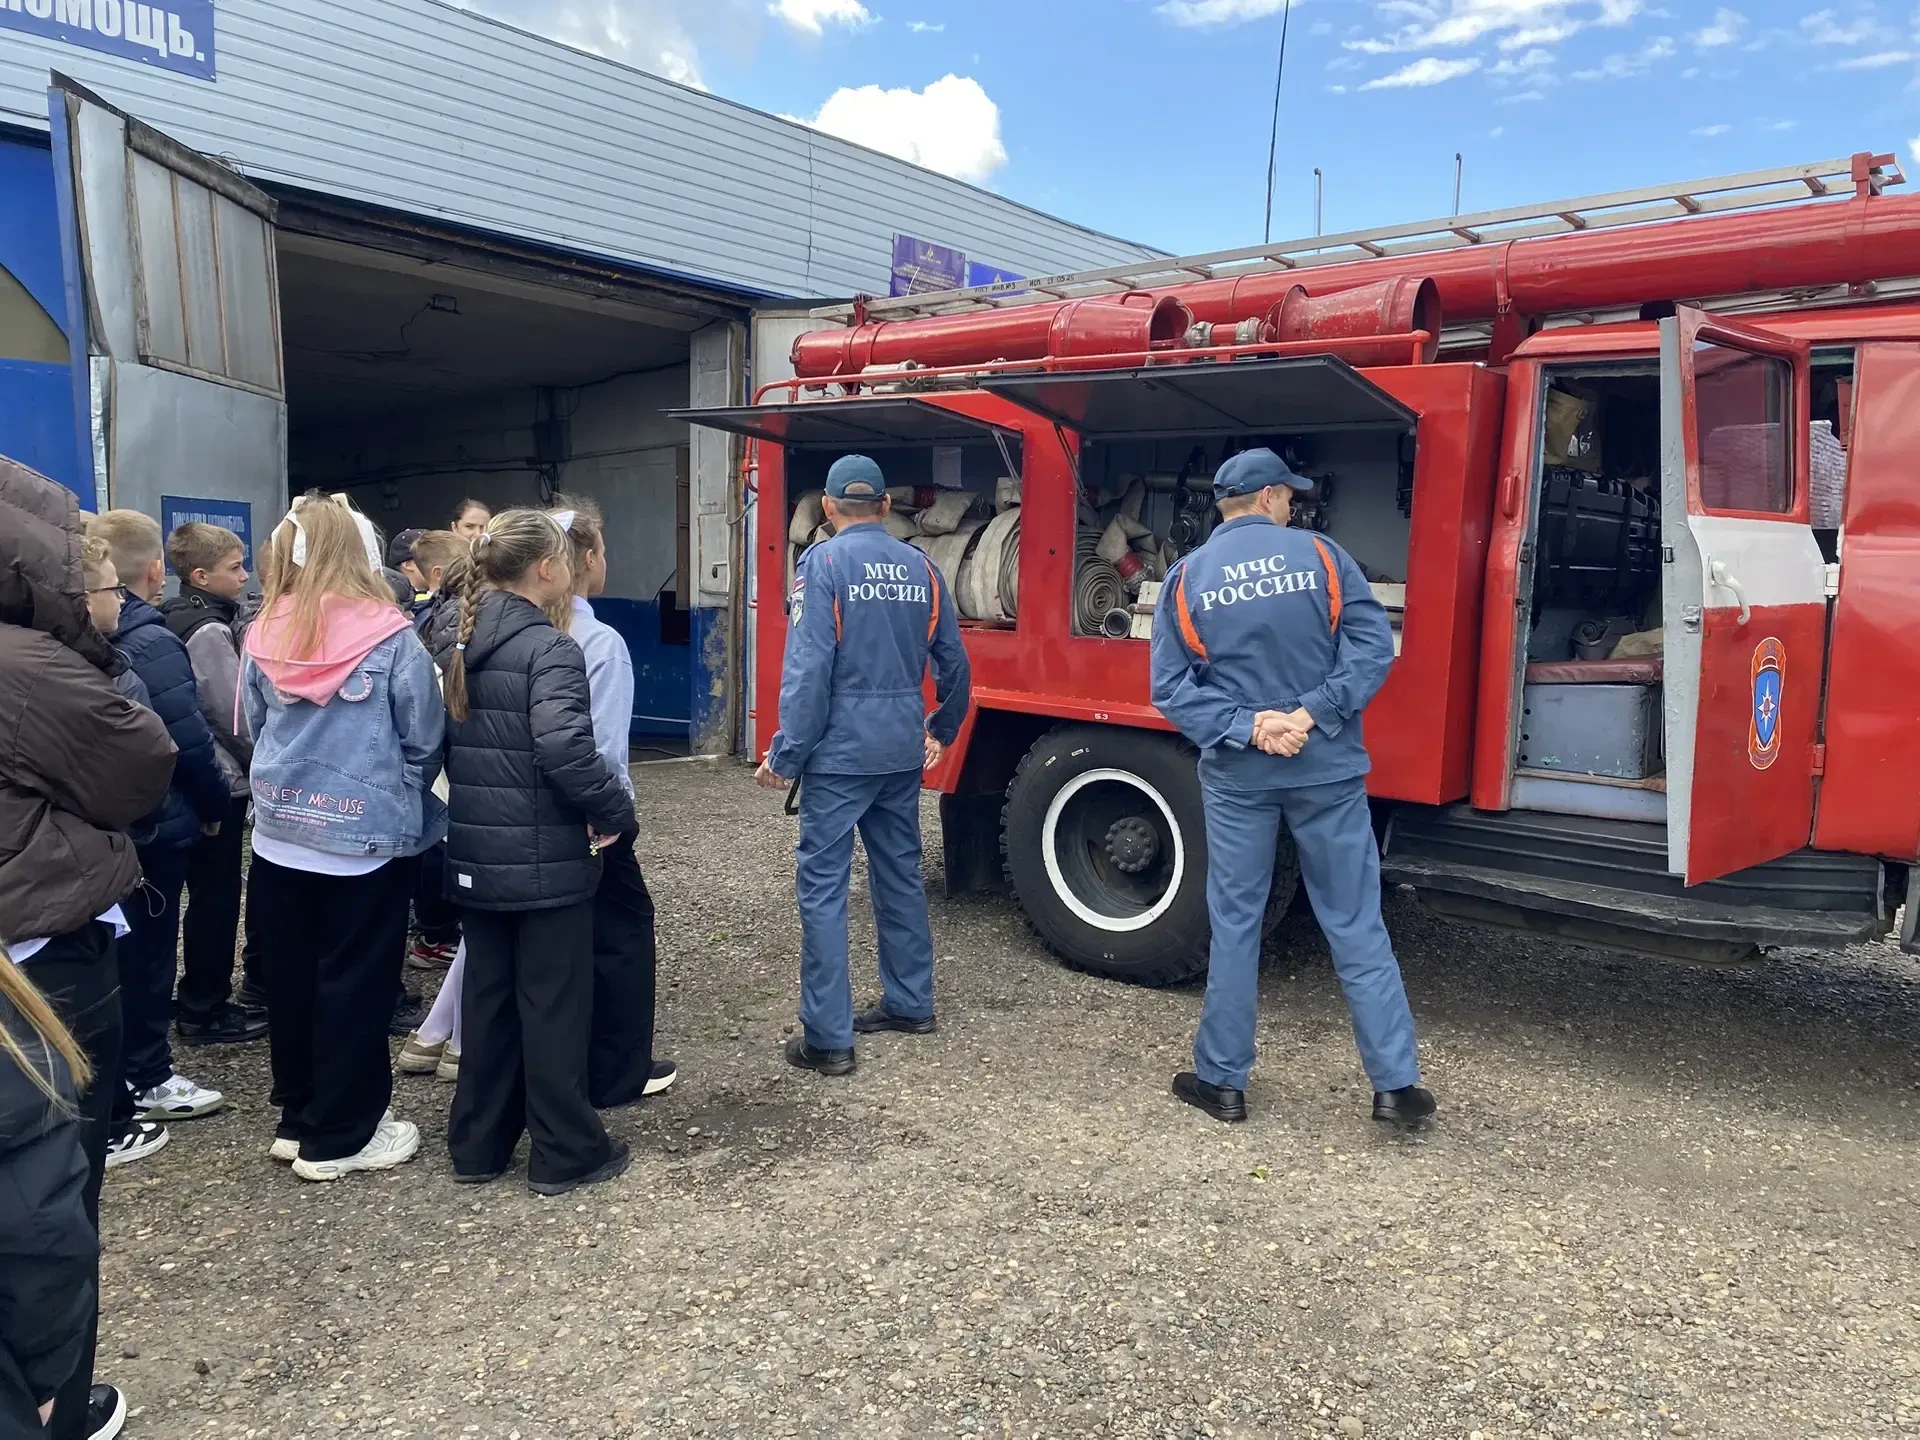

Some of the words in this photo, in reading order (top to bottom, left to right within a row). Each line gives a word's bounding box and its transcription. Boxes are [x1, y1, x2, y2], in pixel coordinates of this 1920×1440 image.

[0, 0, 205, 62] МОЩЬ.
[863, 562, 909, 581] МЧС
[1221, 554, 1287, 583] МЧС
[848, 582, 928, 603] РОССИИ
[1200, 570, 1318, 611] РОССИИ
[254, 779, 302, 803] MICKEY
